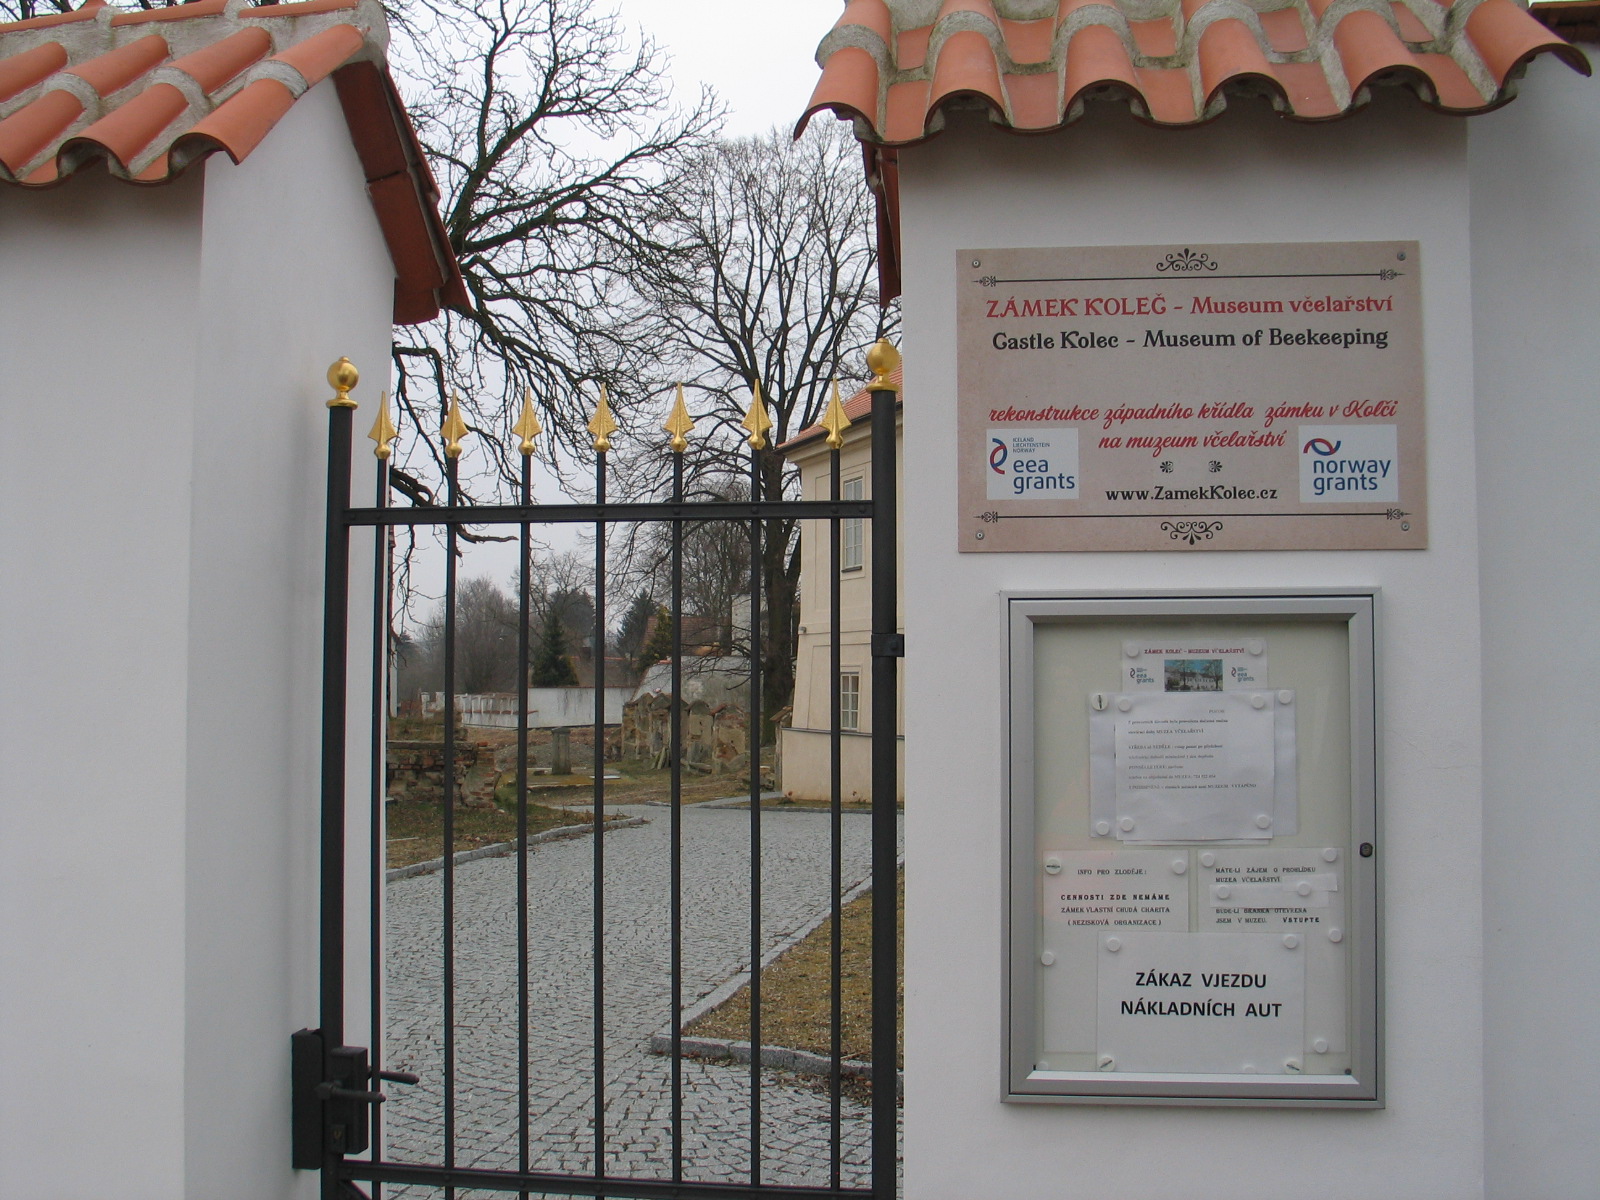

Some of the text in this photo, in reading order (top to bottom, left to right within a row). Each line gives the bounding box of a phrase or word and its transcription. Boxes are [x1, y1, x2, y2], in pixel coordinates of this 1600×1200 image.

[986, 296, 1079, 318] ZÁMEK
[1084, 293, 1167, 316] KOLEČ
[1190, 296, 1284, 314] Museum
[1288, 295, 1393, 313] včelařství
[992, 332, 1055, 350] Castle
[1060, 330, 1119, 349] Kolec
[1143, 329, 1236, 348] Museum
[1242, 329, 1263, 346] of
[1269, 328, 1389, 349] Beekeeping
[989, 405, 1099, 421] rekonstrukce
[1103, 403, 1194, 430] západního
[1198, 402, 1254, 419] křídla
[1264, 401, 1324, 428] zámku
[1329, 404, 1339, 417] v
[1098, 430, 1287, 457] na muzeum včelařství
[1013, 459, 1049, 473] eea
[1313, 459, 1391, 478] norway
[1013, 473, 1075, 494] grants
[1105, 485, 1278, 500] www.ZamekKolec.cz
[1313, 474, 1378, 495] grants
[1135, 969, 1267, 988] ZÁKAZ VJEZDU
[1121, 997, 1282, 1017] NÁKLADNÍCH AUT
